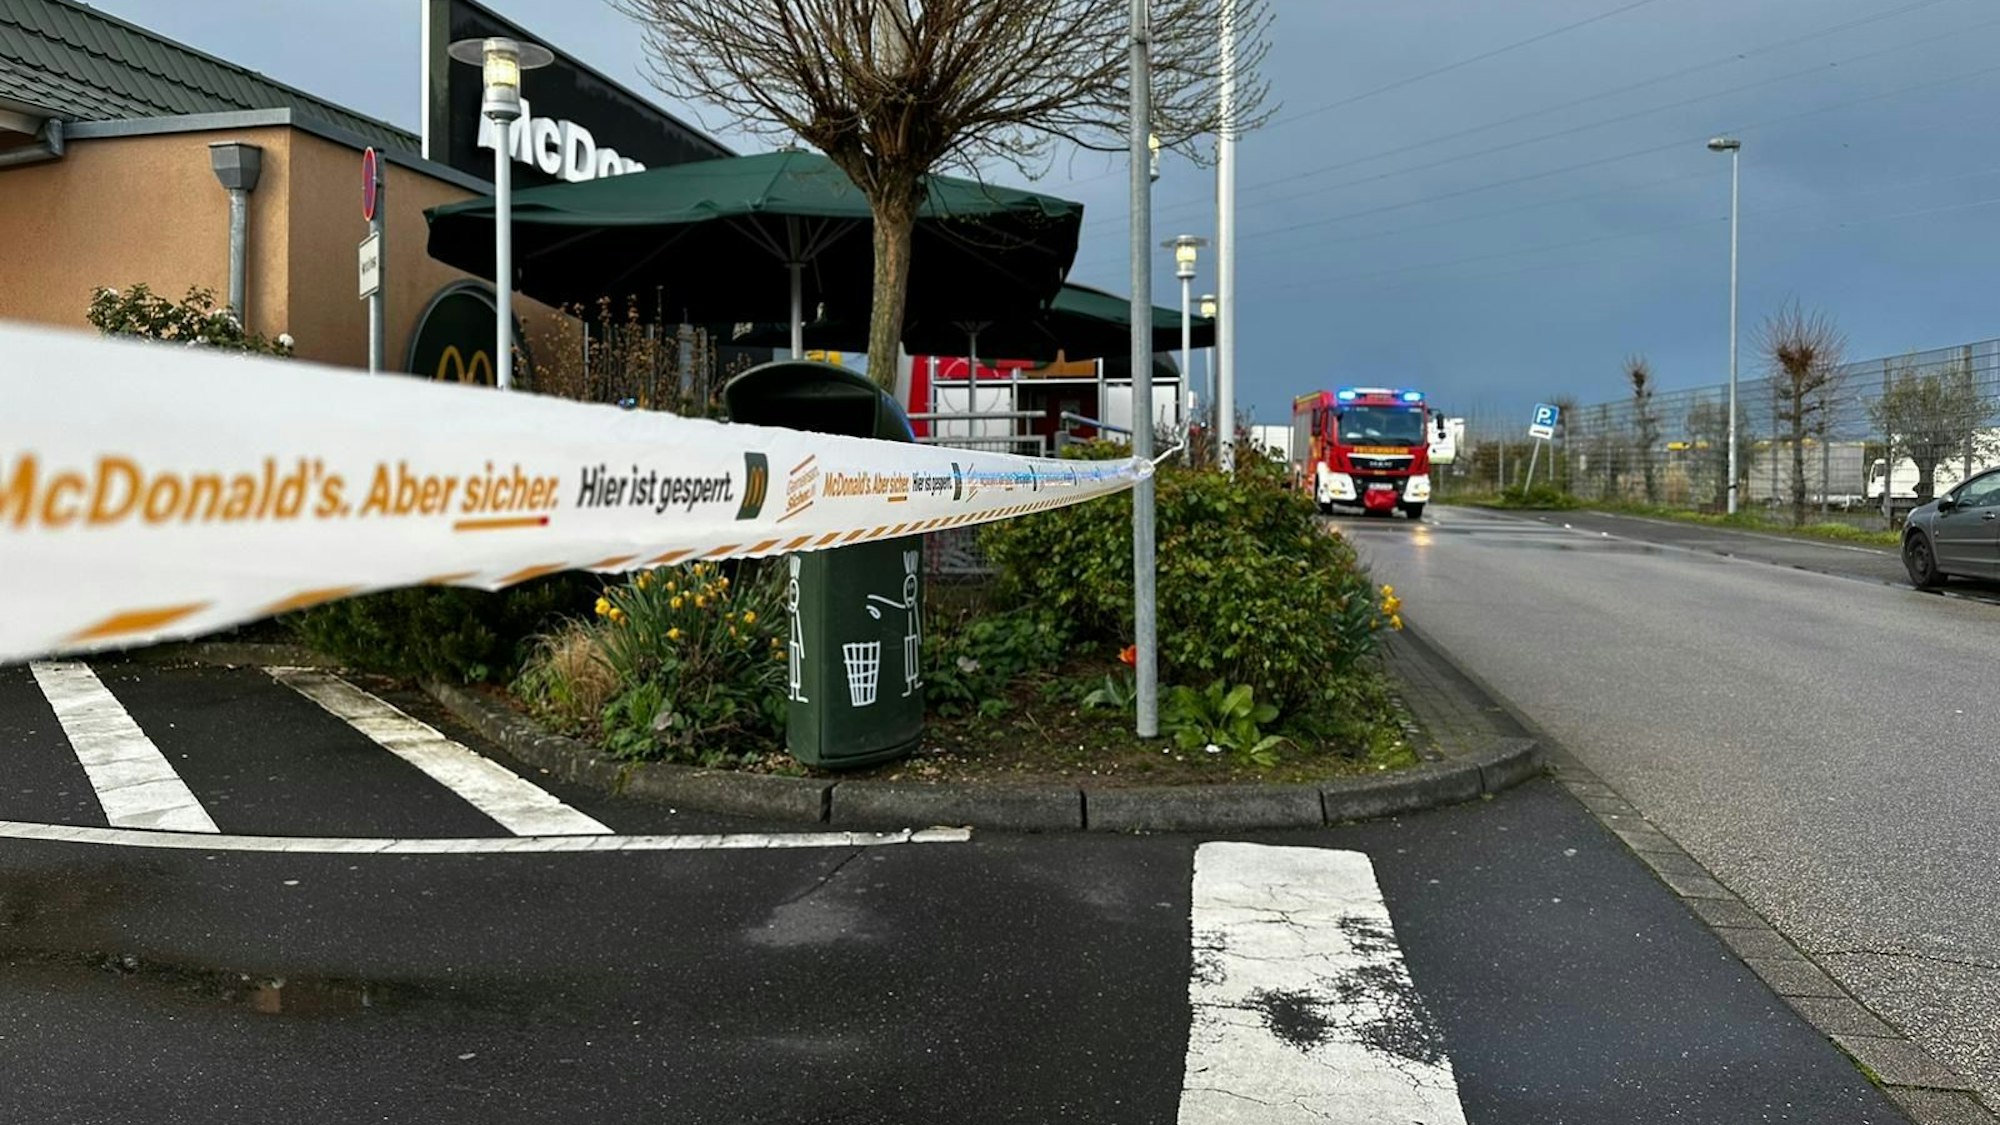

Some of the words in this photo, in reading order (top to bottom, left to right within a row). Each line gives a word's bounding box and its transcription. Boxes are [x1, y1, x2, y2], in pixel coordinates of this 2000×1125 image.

[477, 98, 647, 183] McDo
[1536, 407, 1551, 424] P
[360, 462, 457, 516] Aber
[461, 462, 559, 513] sicher.
[577, 464, 627, 508] Hier
[629, 464, 656, 502] ist
[656, 471, 733, 514] gesperrt.
[872, 473, 890, 494] Aber
